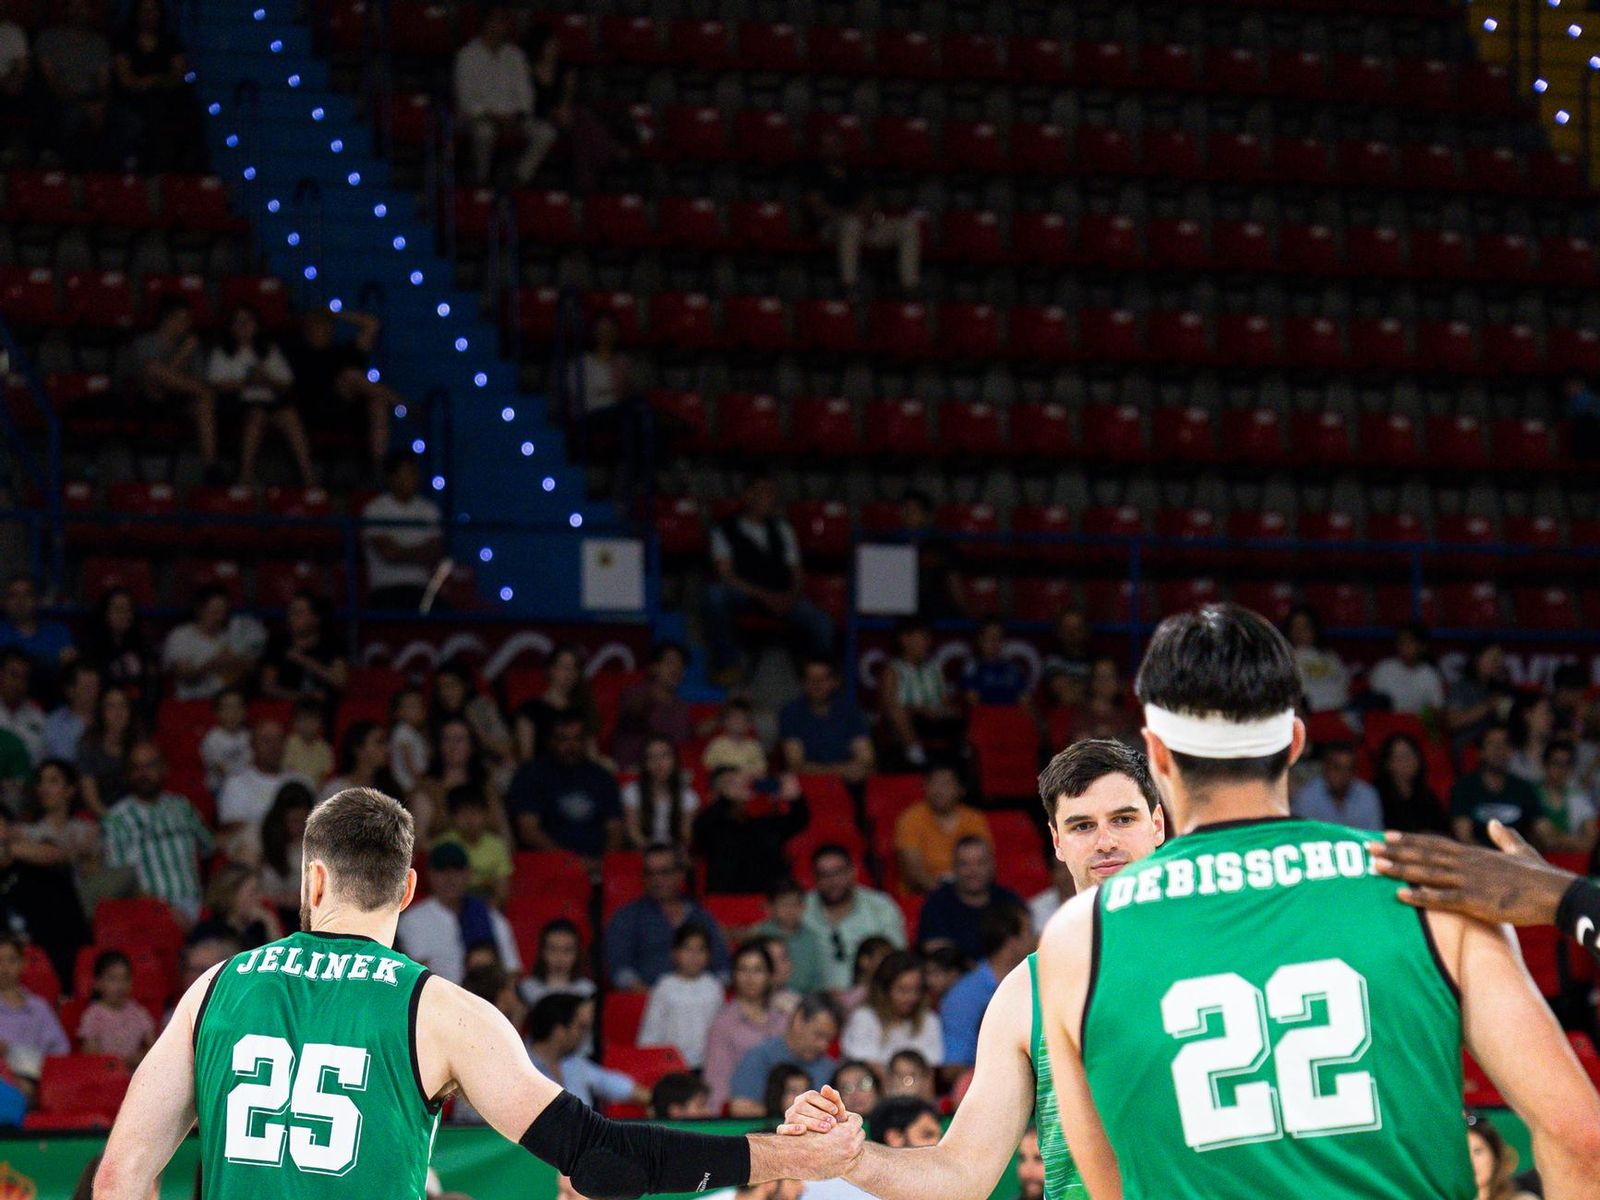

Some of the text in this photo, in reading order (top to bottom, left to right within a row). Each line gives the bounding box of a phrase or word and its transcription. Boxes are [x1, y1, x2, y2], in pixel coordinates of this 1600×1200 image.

[1105, 840, 1380, 912] DEBISSCHO
[236, 946, 405, 986] JELINEK
[225, 1034, 370, 1176] 25
[1160, 957, 1382, 1152] 22
